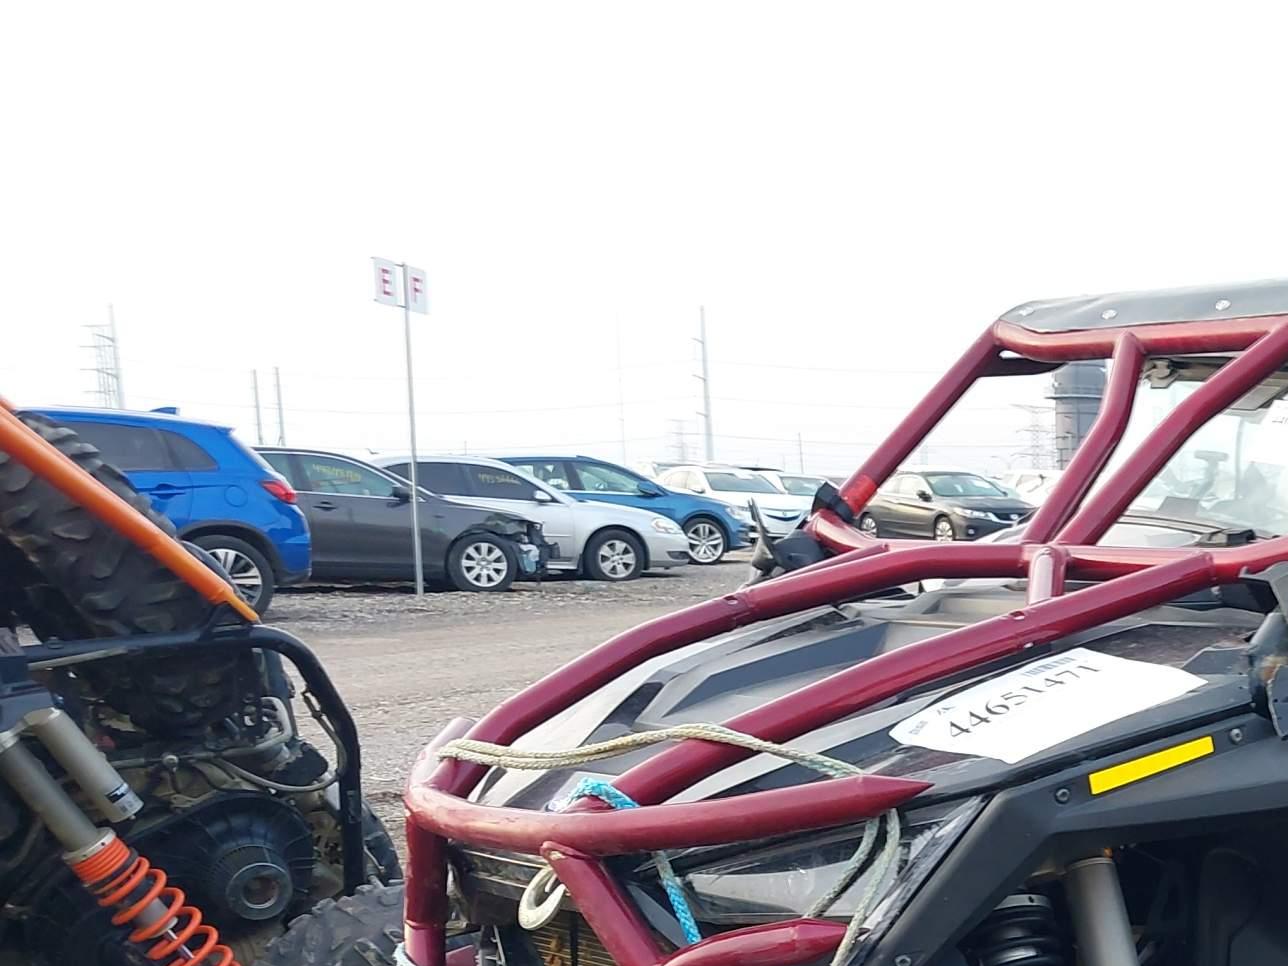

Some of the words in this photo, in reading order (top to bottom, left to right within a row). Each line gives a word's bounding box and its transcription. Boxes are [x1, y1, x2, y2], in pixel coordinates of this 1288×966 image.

[380, 268, 393, 296] E
[411, 276, 424, 304] F
[948, 664, 1102, 738] 44651471
